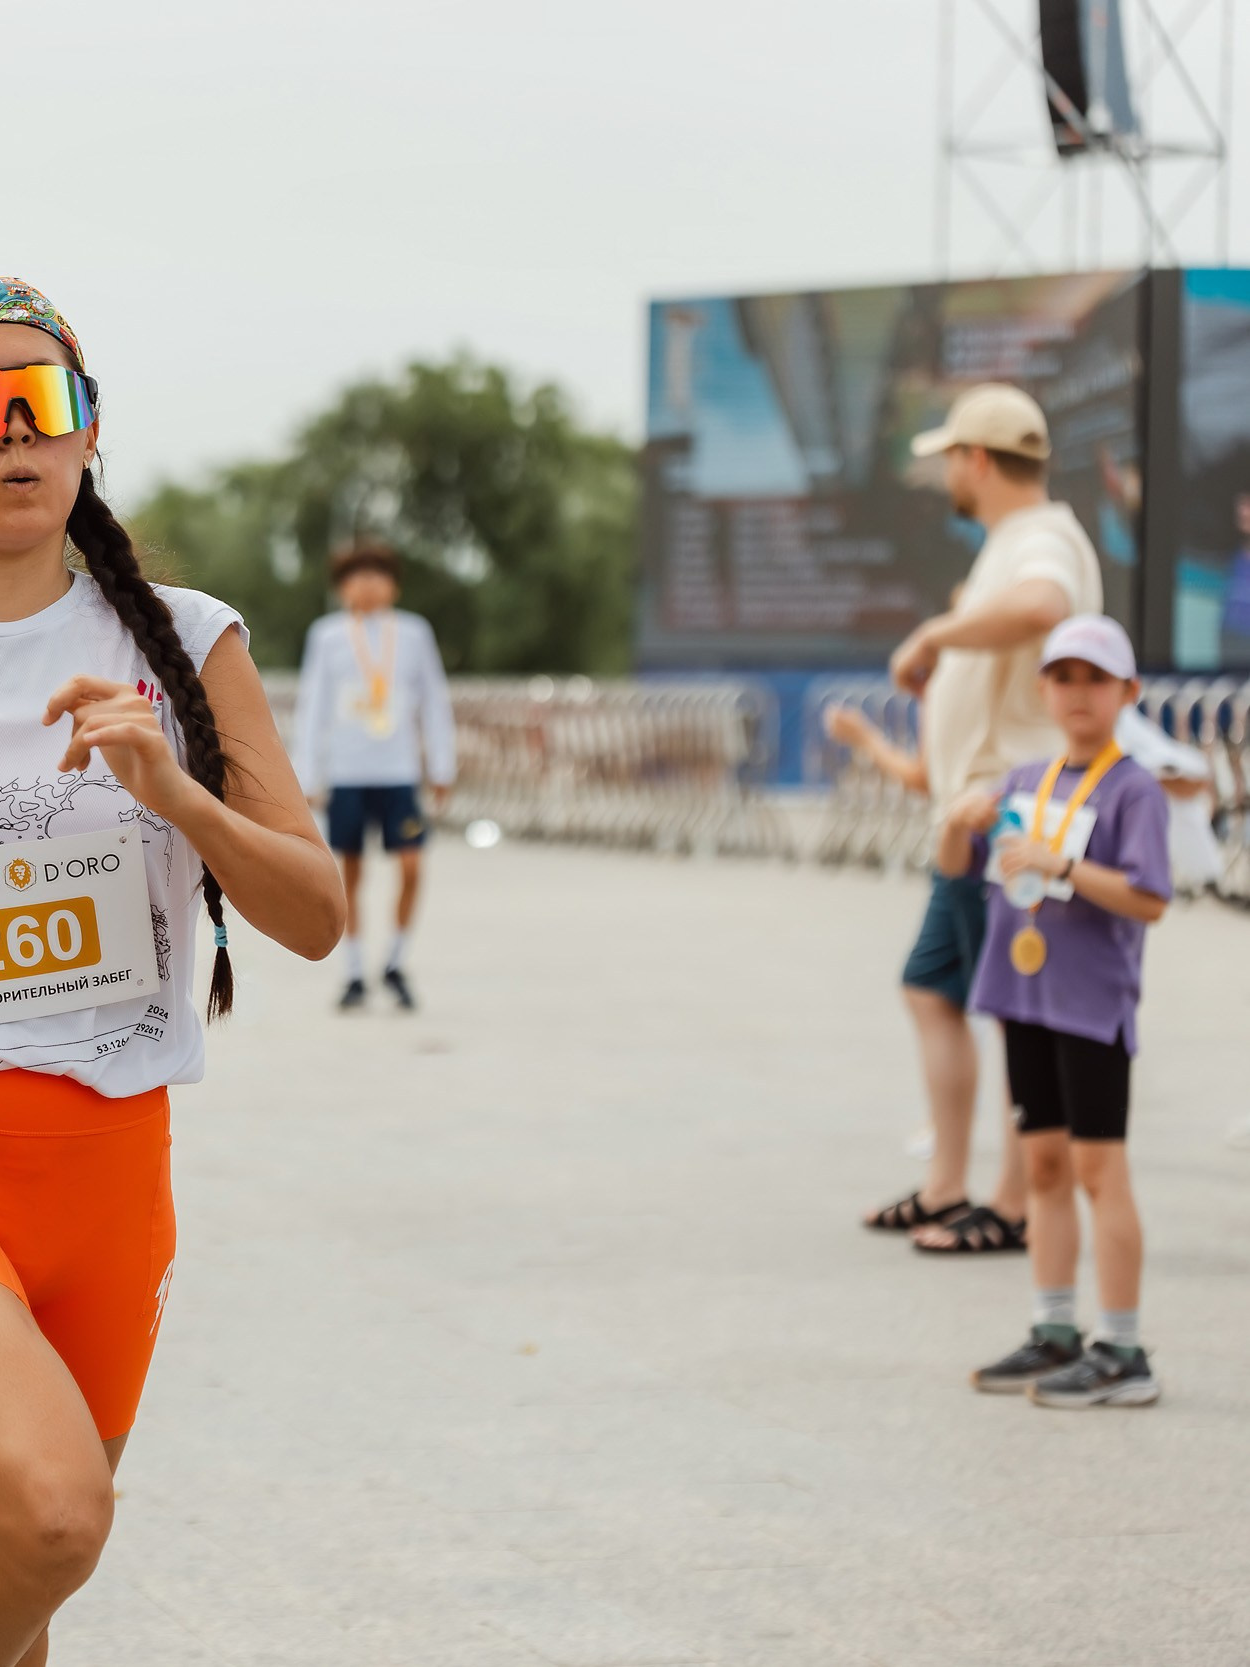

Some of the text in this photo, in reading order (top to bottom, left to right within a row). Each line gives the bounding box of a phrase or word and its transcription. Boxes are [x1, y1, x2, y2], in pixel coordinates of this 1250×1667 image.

[44, 853, 120, 882] D'ORO
[92, 969, 133, 987] ЗАБЕГ
[146, 1004, 169, 1020] 2024
[96, 1036, 130, 1054] 53.126
